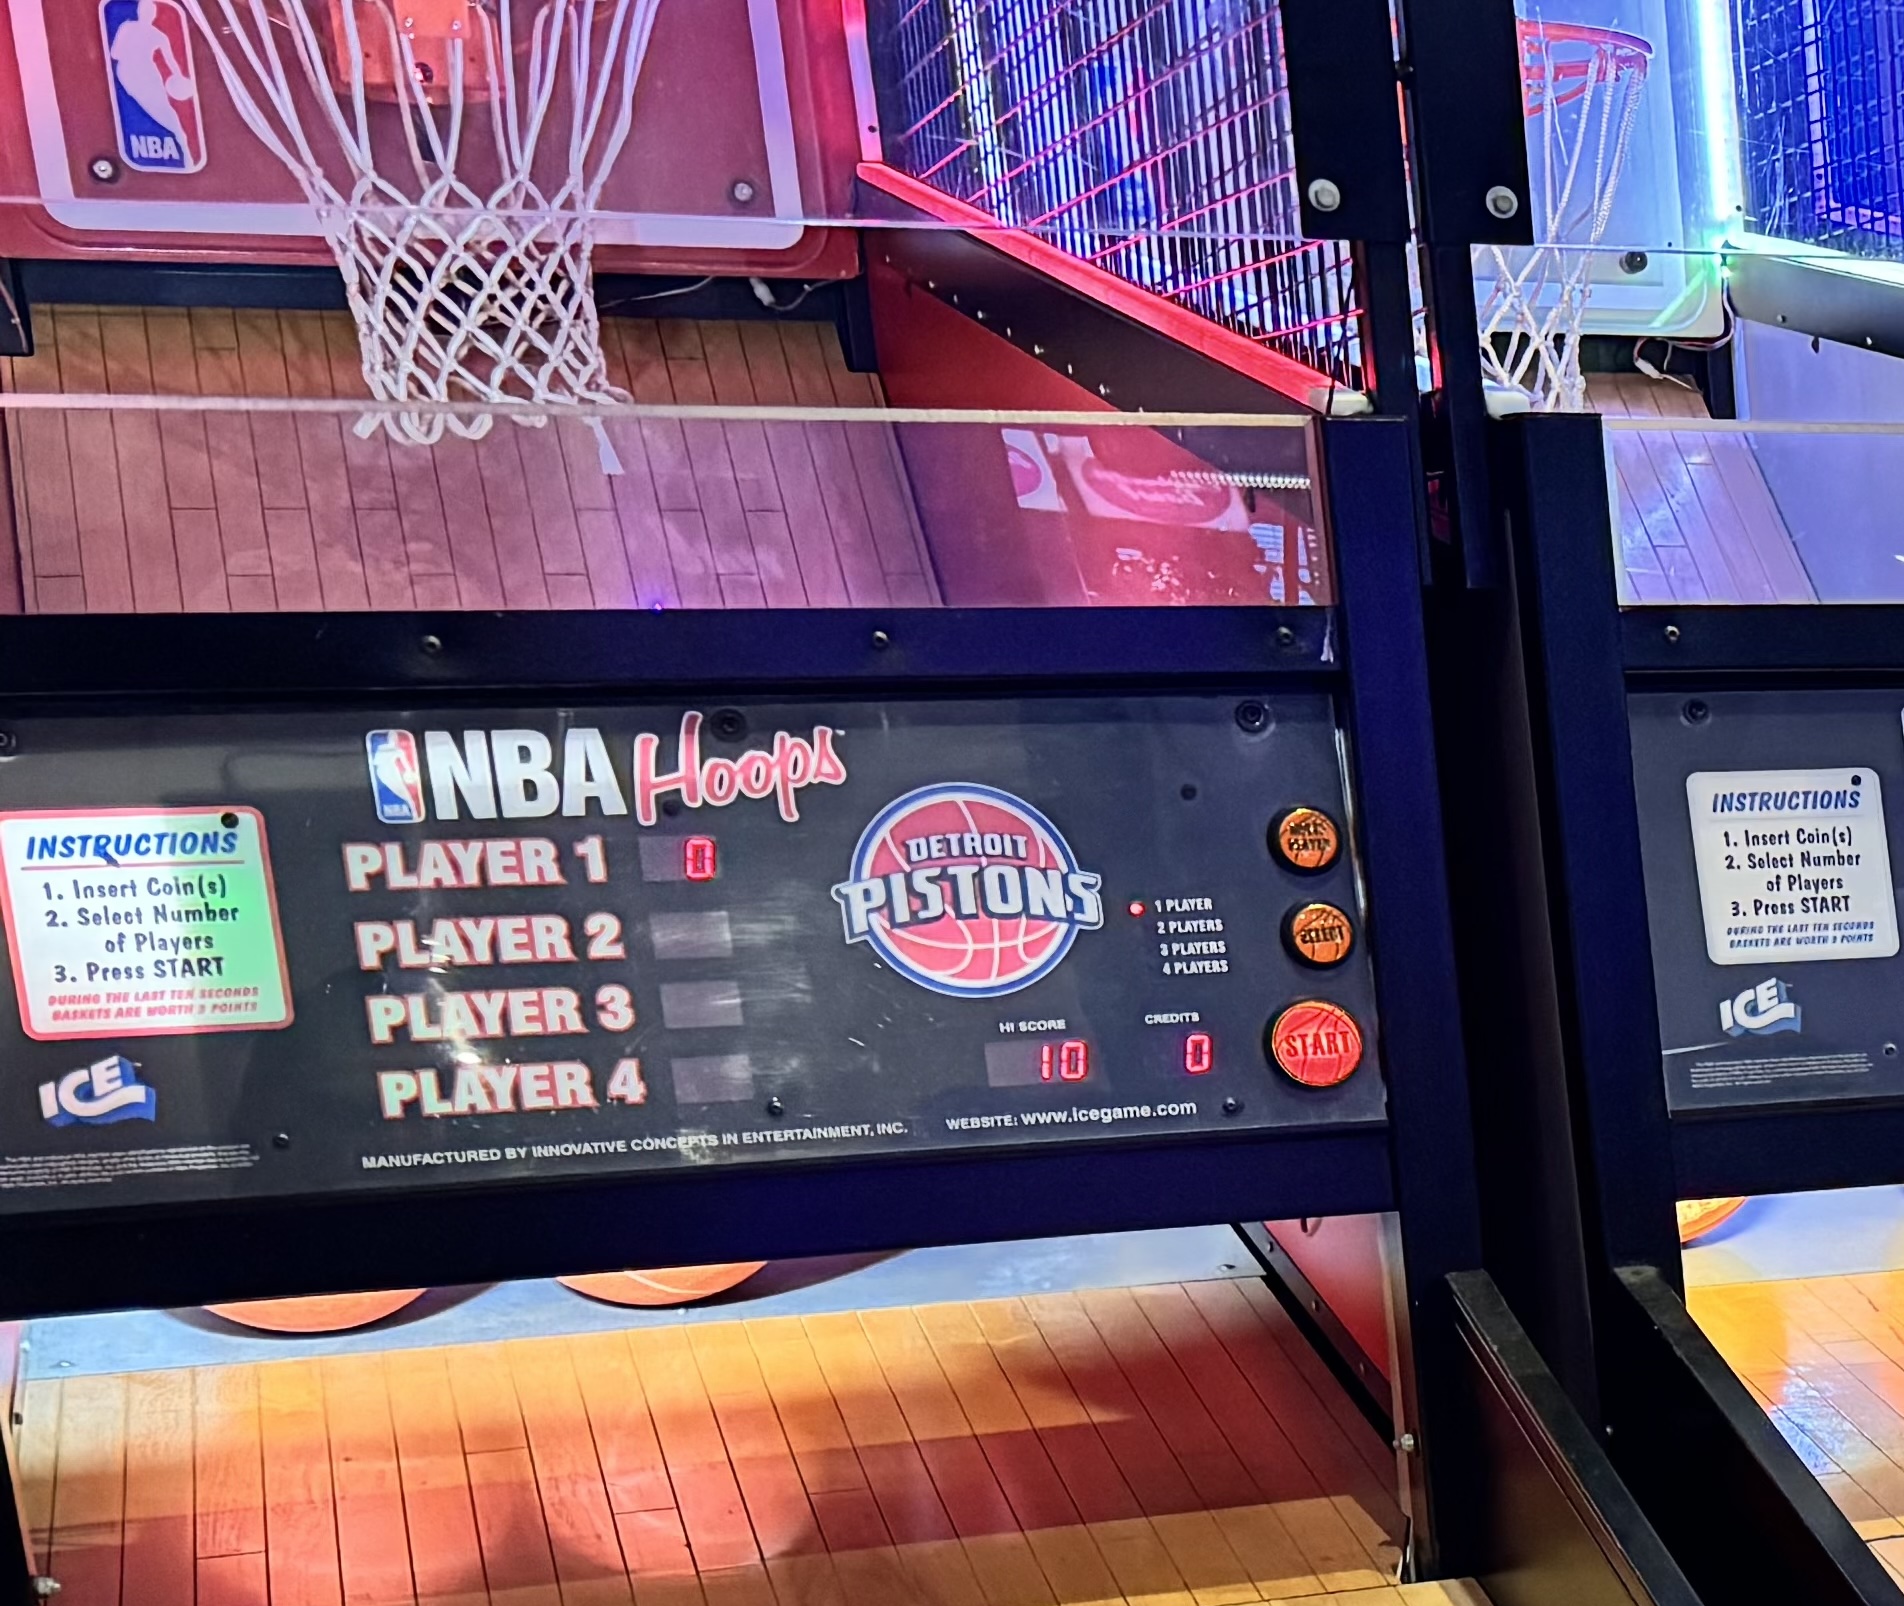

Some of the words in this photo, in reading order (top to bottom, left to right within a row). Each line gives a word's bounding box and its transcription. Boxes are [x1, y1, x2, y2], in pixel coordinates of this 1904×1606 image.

[130, 134, 180, 159] NBA
[424, 728, 628, 820] NBA
[633, 712, 847, 827] Hoops
[1712, 790, 1860, 813] INSTRUCTIONS
[27, 832, 239, 860] INSTRUCTIONS
[905, 833, 1027, 862] DETROIT
[1724, 831, 1738, 847] 1.
[1745, 830, 1790, 847] Insert
[1796, 826, 1852, 847] Coin(s)
[342, 837, 568, 892] PLAYER
[572, 835, 609, 883] 1
[1725, 854, 1741, 870] 2.
[1748, 853, 1794, 869] Select
[1801, 849, 1861, 868] Number
[43, 882, 63, 900] 1.
[73, 879, 137, 898] Insert
[147, 874, 226, 898] Coin(s)
[1766, 875, 1781, 892] of
[1788, 874, 1844, 896] Players
[841, 864, 1100, 935] PISTONS
[1166, 898, 1213, 912] PLAYER
[1731, 901, 1746, 917] 3.
[1754, 899, 1795, 915] Press
[1801, 896, 1851, 914] START
[45, 910, 68, 927] 2.
[77, 905, 143, 926] Select
[154, 902, 240, 924] Number
[1169, 919, 1224, 934] PLAYERS
[105, 932, 126, 953] of
[135, 931, 214, 956] Players
[353, 914, 578, 971] PLAYER
[584, 913, 626, 960] 2
[1171, 941, 1226, 956] PLAYERS
[53, 965, 77, 983] 3.
[86, 962, 145, 982] Press
[154, 957, 224, 978] START
[1174, 959, 1229, 975] PLAYERS
[365, 988, 591, 1044] PLAYER
[596, 984, 635, 1031] 3
[1720, 977, 1795, 1031] ICE
[999, 1022, 1014, 1033] HI
[1019, 1019, 1067, 1032] SCORE
[1144, 1012, 1200, 1024] CREDITS
[1184, 1032, 1212, 1075] 0
[1285, 1031, 1350, 1058] START
[1041, 1040, 1088, 1081] 10
[39, 1055, 147, 1120] ICE
[376, 1061, 600, 1120] PLAYER
[606, 1058, 647, 1105] 4
[946, 1115, 1018, 1131] WEBSITE:
[1021, 1101, 1197, 1125] www.icegame.com
[362, 1149, 501, 1169] MANUFACTURED
[505, 1145, 527, 1160] BY
[531, 1139, 627, 1159] INNOVATIVE
[630, 1133, 718, 1153] CONCEPTS
[722, 1131, 738, 1147] IN
[742, 1124, 874, 1146] ENTERTAINMENT,
[876, 1122, 908, 1137] INC.
